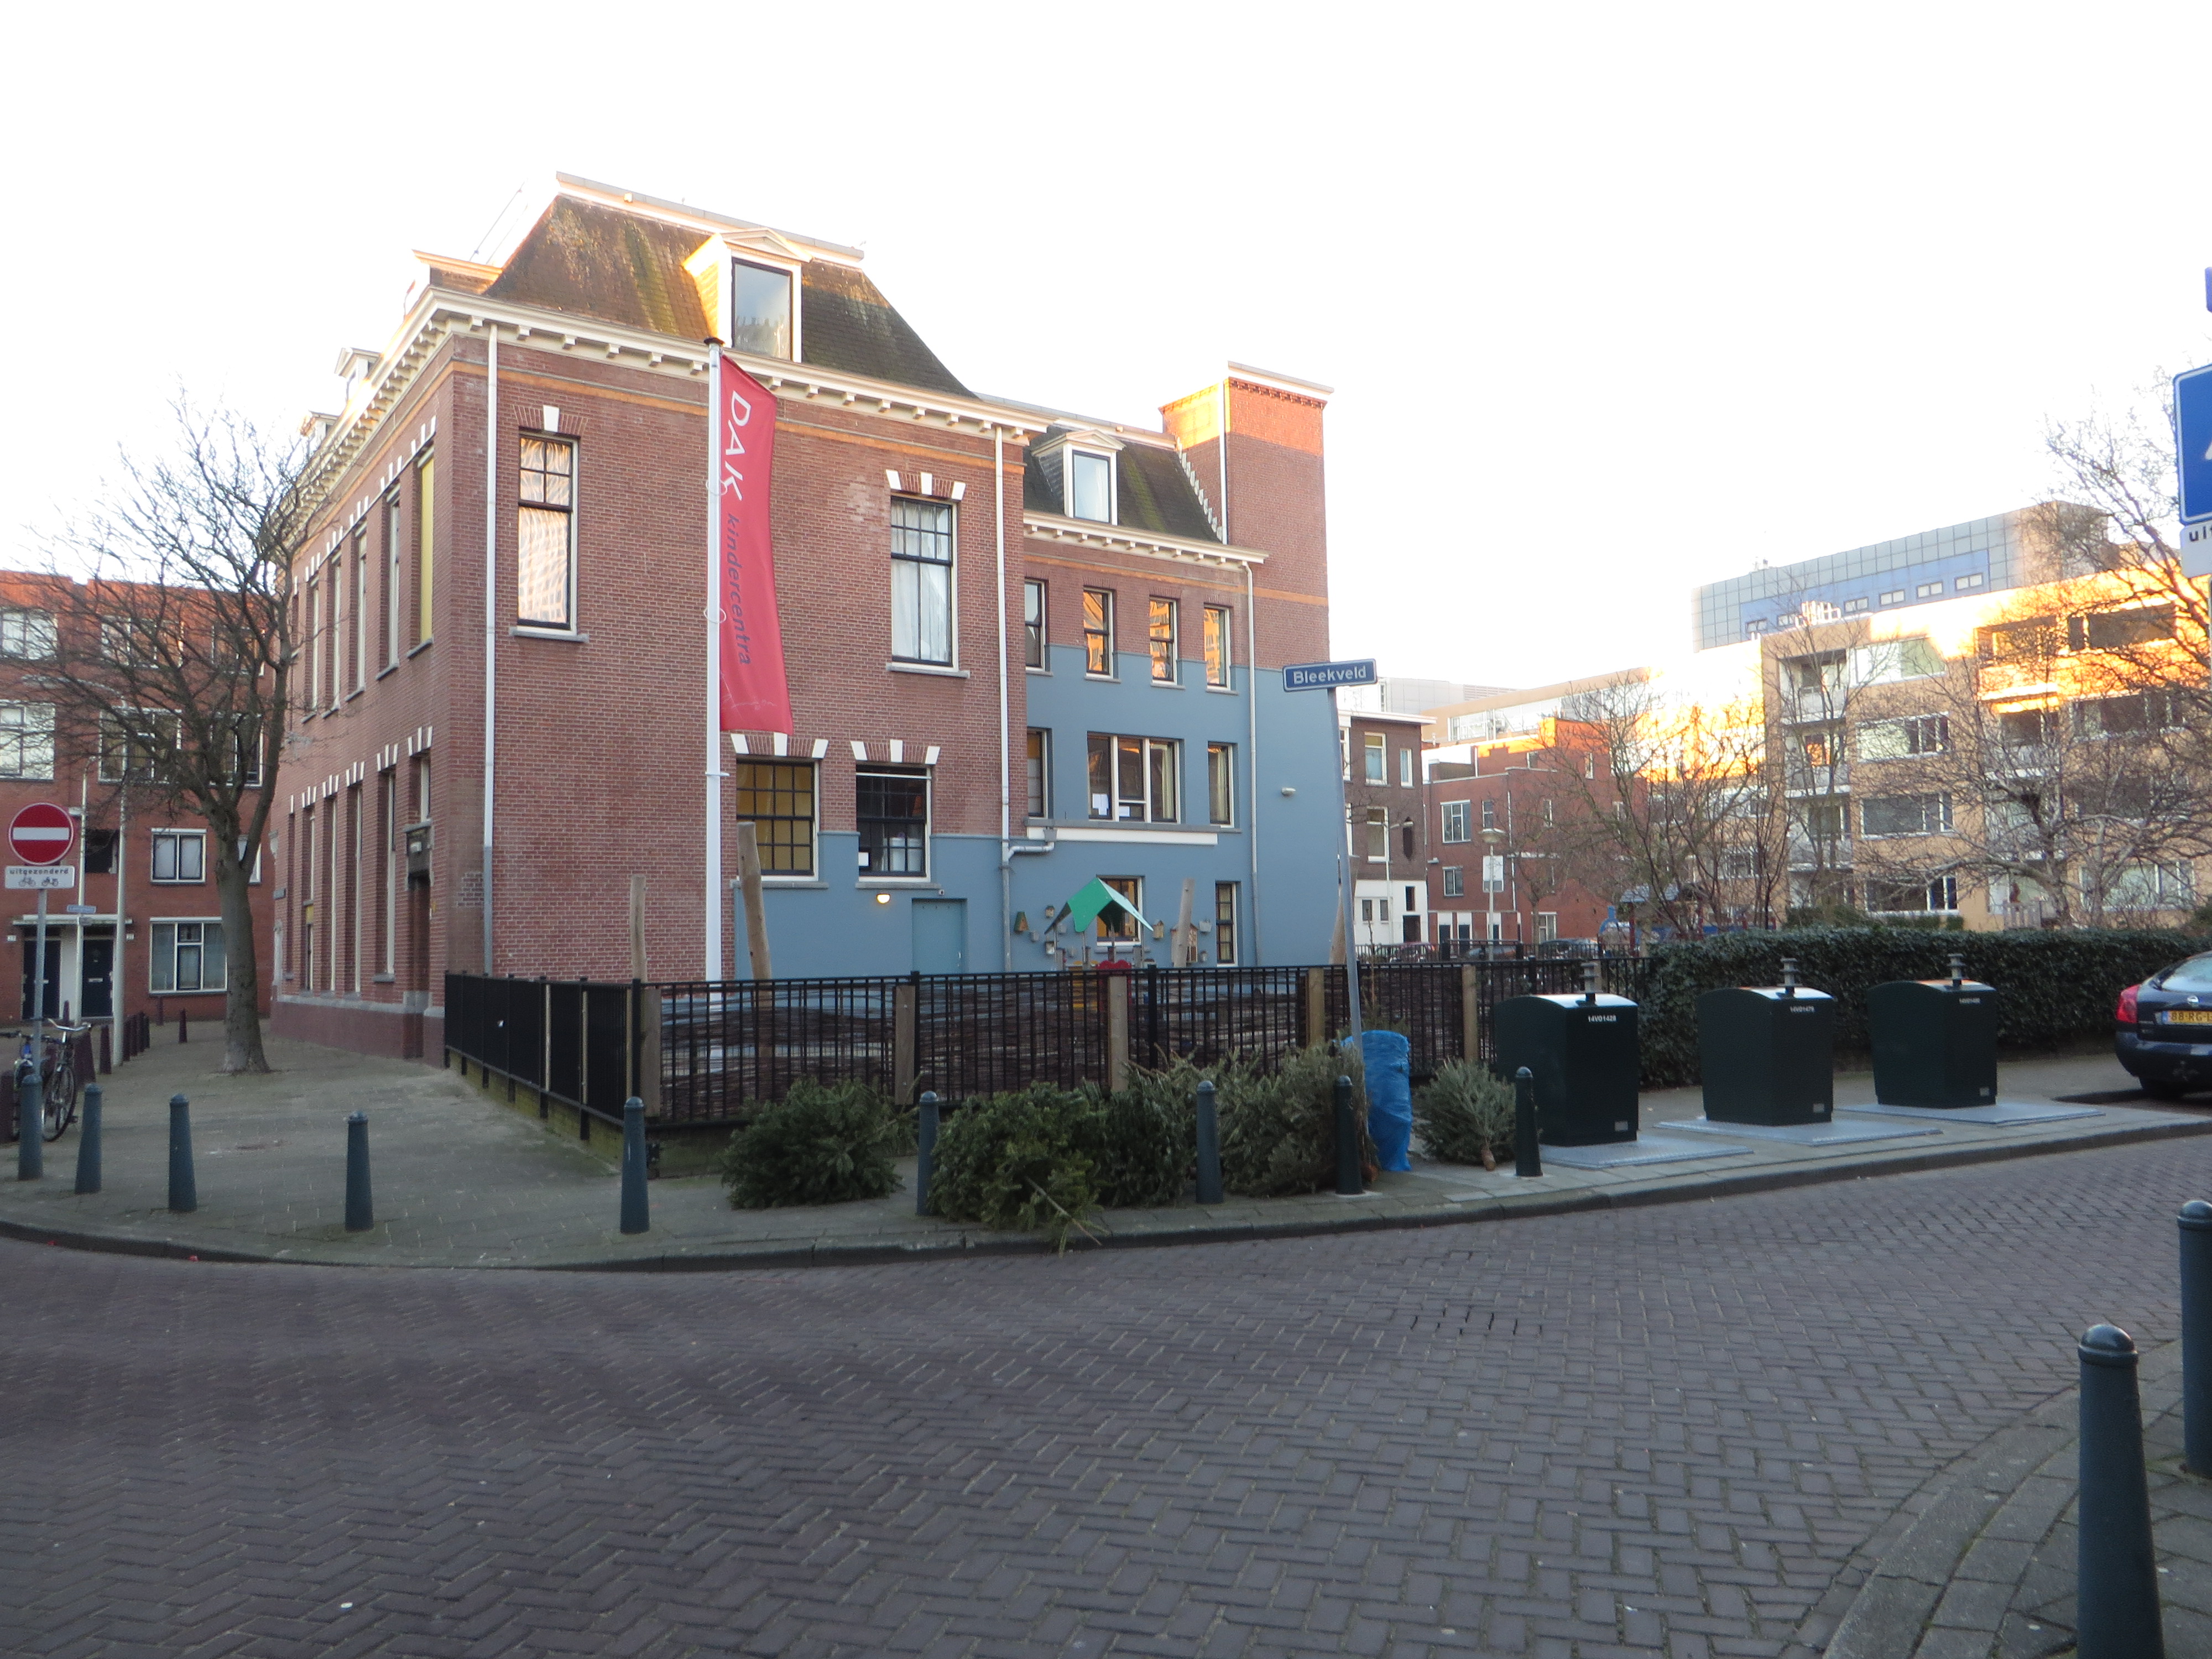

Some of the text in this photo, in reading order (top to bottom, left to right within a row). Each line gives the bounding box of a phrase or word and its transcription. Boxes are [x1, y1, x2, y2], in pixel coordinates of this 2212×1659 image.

[724, 390, 752, 665] DAK kindercentra
[1292, 665, 1367, 685] Bleekveld
